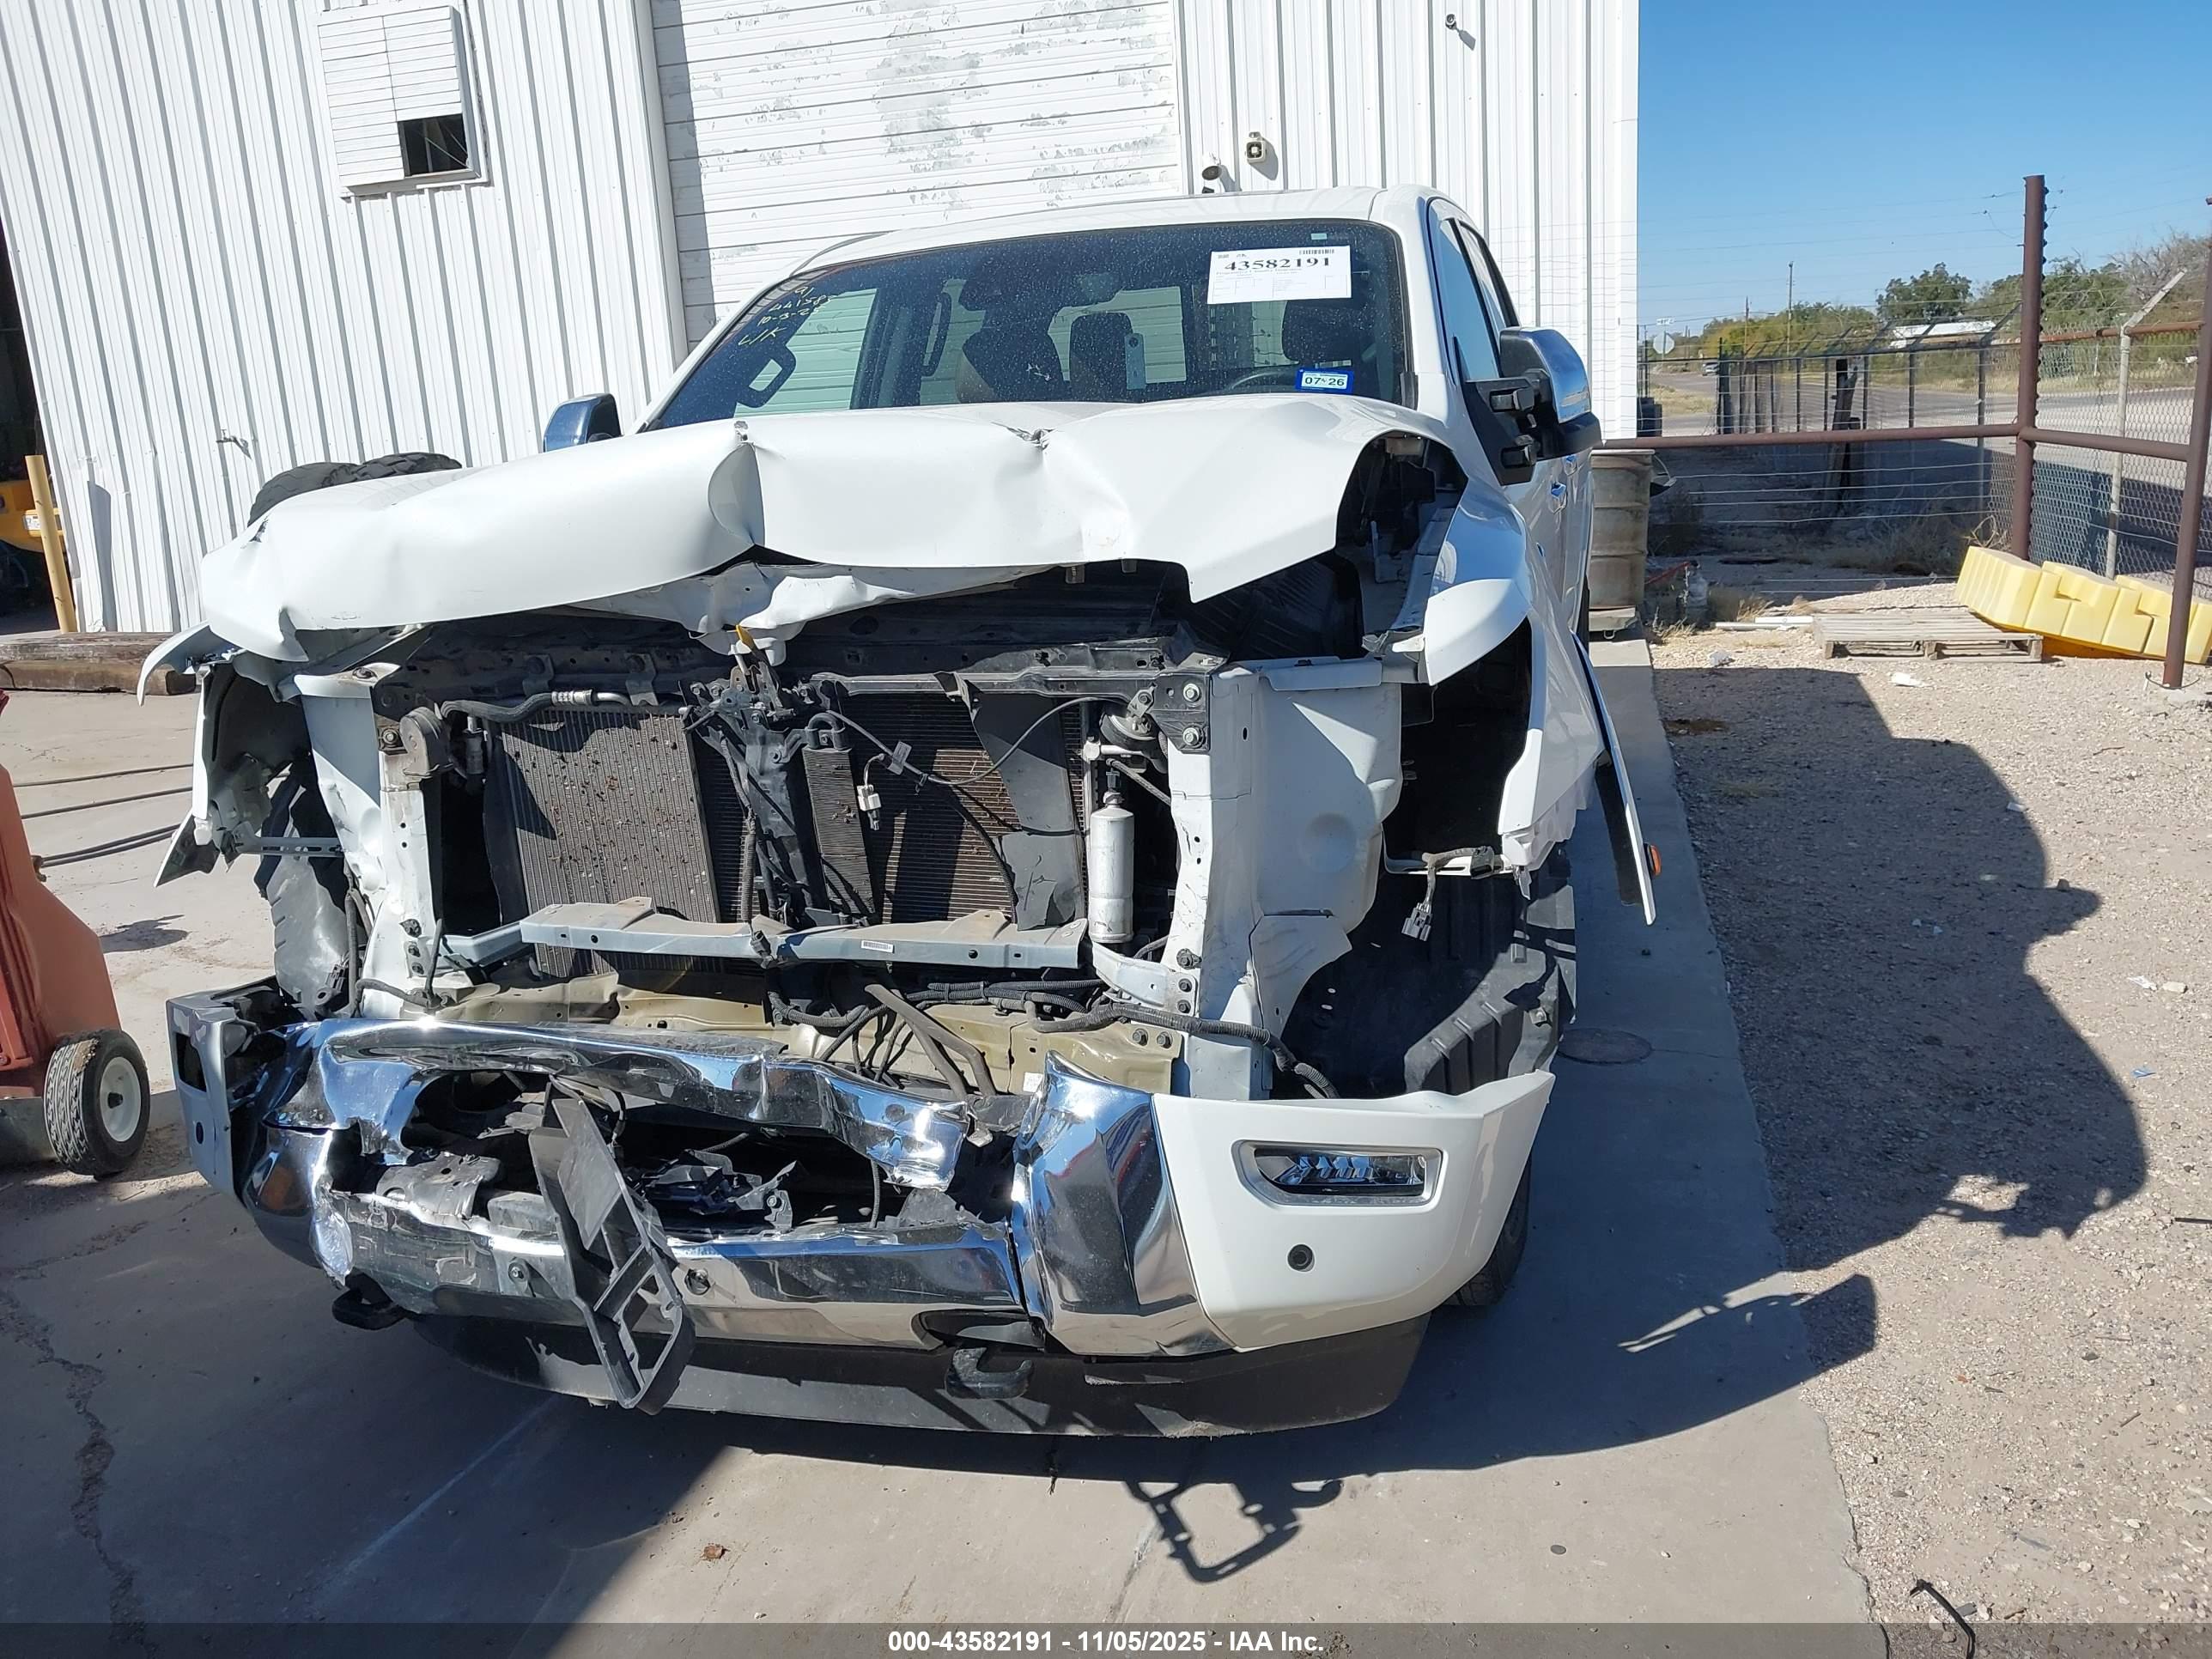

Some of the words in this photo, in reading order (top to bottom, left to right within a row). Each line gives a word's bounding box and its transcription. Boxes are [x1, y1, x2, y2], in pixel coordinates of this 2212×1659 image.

[1224, 257, 1331, 271] 43582191
[1304, 376, 1322, 385] 07
[1328, 378, 1345, 386] 26
